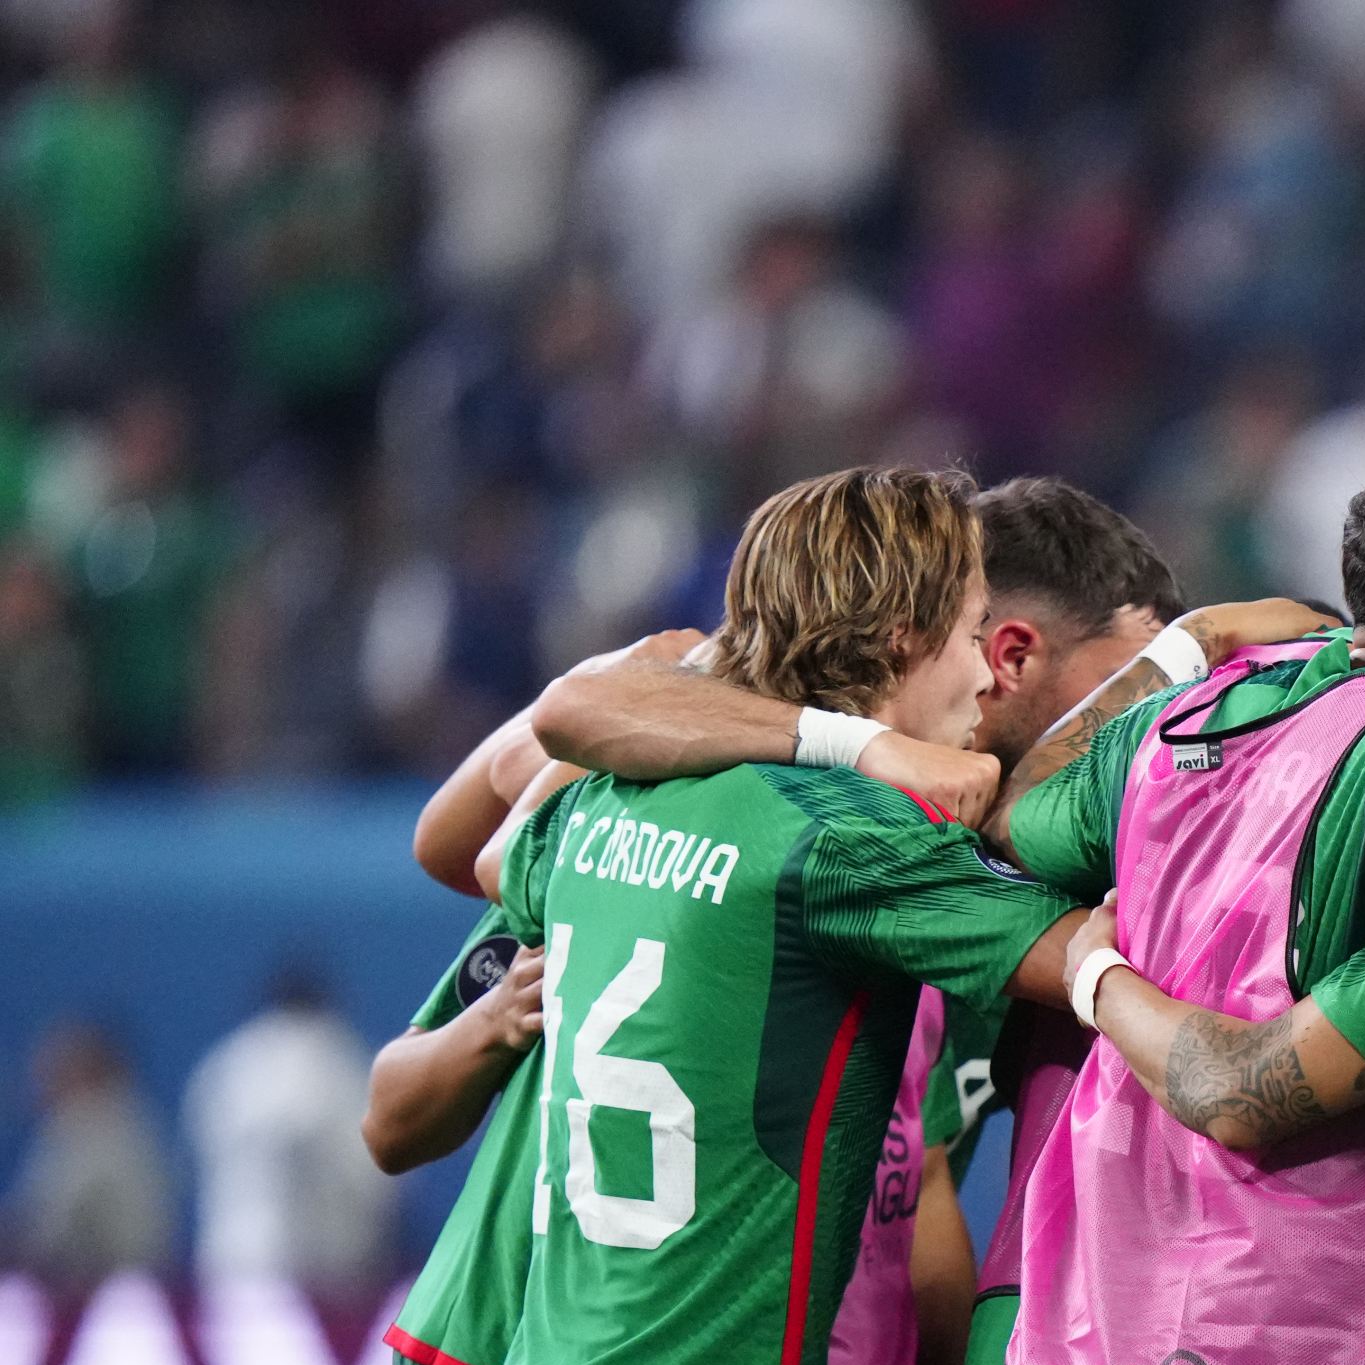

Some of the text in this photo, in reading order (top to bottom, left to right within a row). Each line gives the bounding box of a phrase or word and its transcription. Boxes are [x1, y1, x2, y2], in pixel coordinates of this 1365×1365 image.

[1176, 754, 1205, 770] savi
[574, 807, 740, 905] CÓRDOVA
[532, 922, 696, 1250] 16
